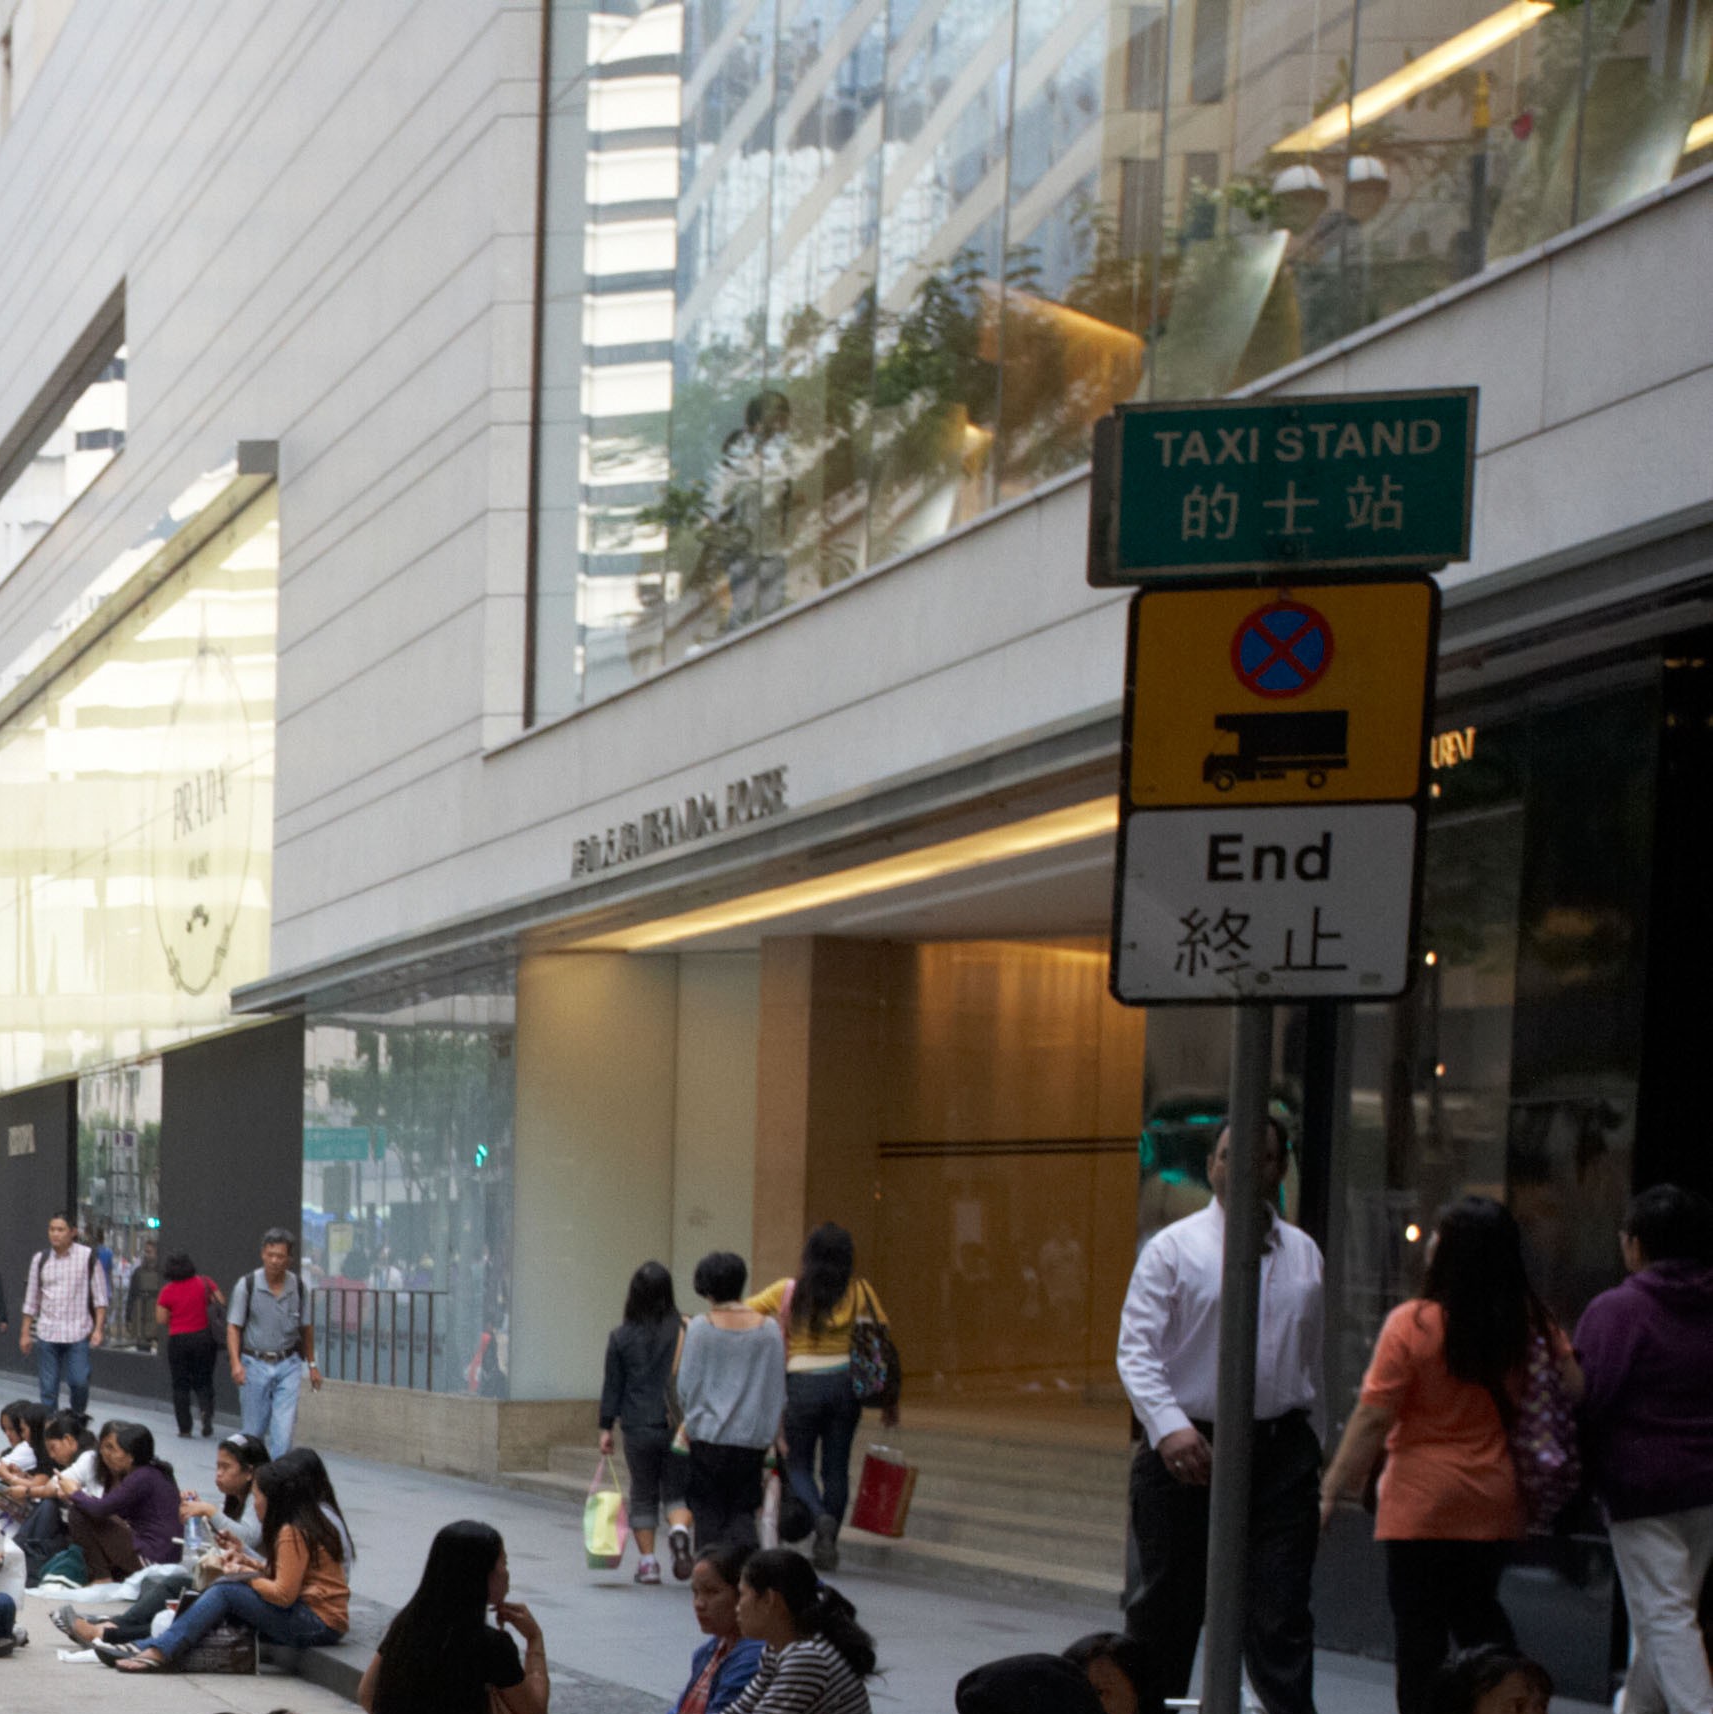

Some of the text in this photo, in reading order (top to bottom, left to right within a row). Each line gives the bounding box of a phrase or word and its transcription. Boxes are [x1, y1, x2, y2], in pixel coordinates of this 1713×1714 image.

[1154, 419, 1442, 467] TAXI STAND
[1181, 474, 1404, 541] 的士站
[1207, 831, 1333, 882] End
[1175, 906, 1348, 976] 終止
